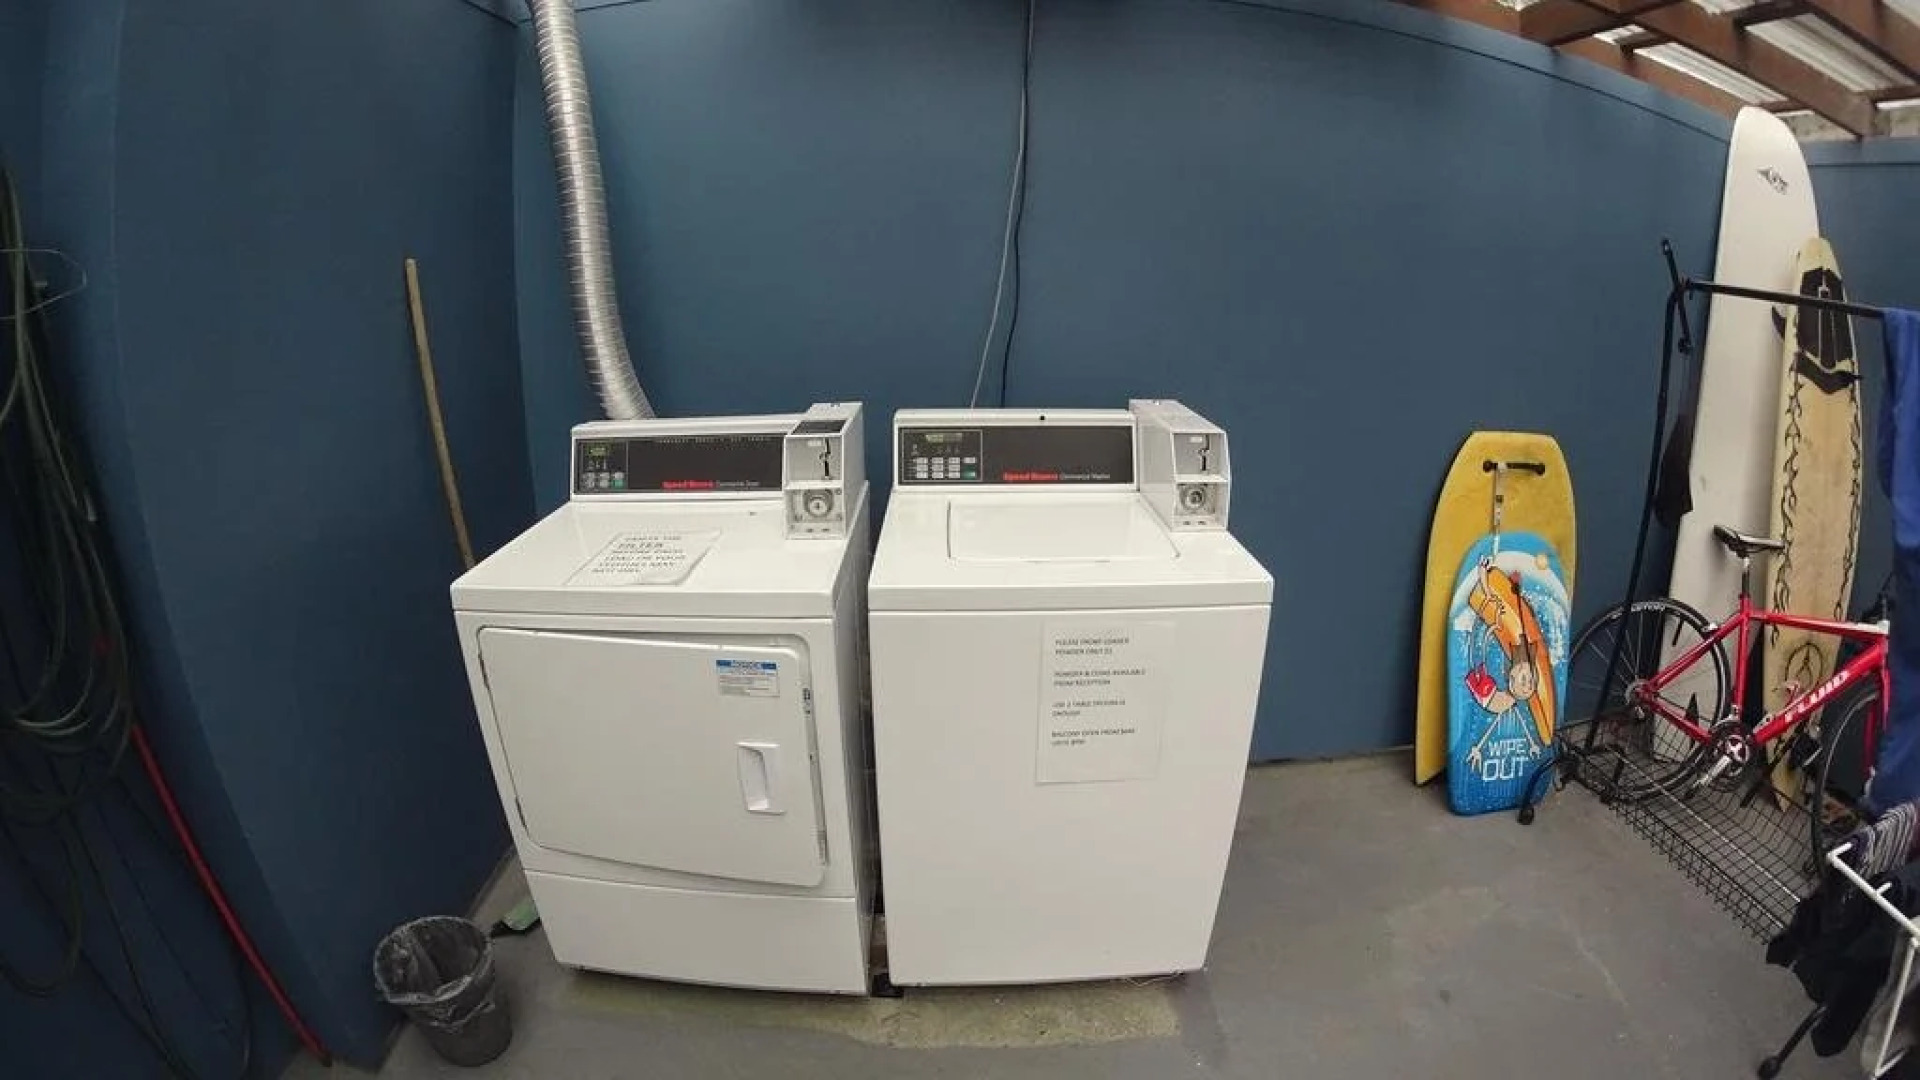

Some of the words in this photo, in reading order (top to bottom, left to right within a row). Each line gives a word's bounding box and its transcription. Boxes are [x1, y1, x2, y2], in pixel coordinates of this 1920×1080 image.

[1784, 671, 1850, 723] FLUID
[1488, 738, 1526, 757] WIPE
[1482, 757, 1528, 782] OUT
